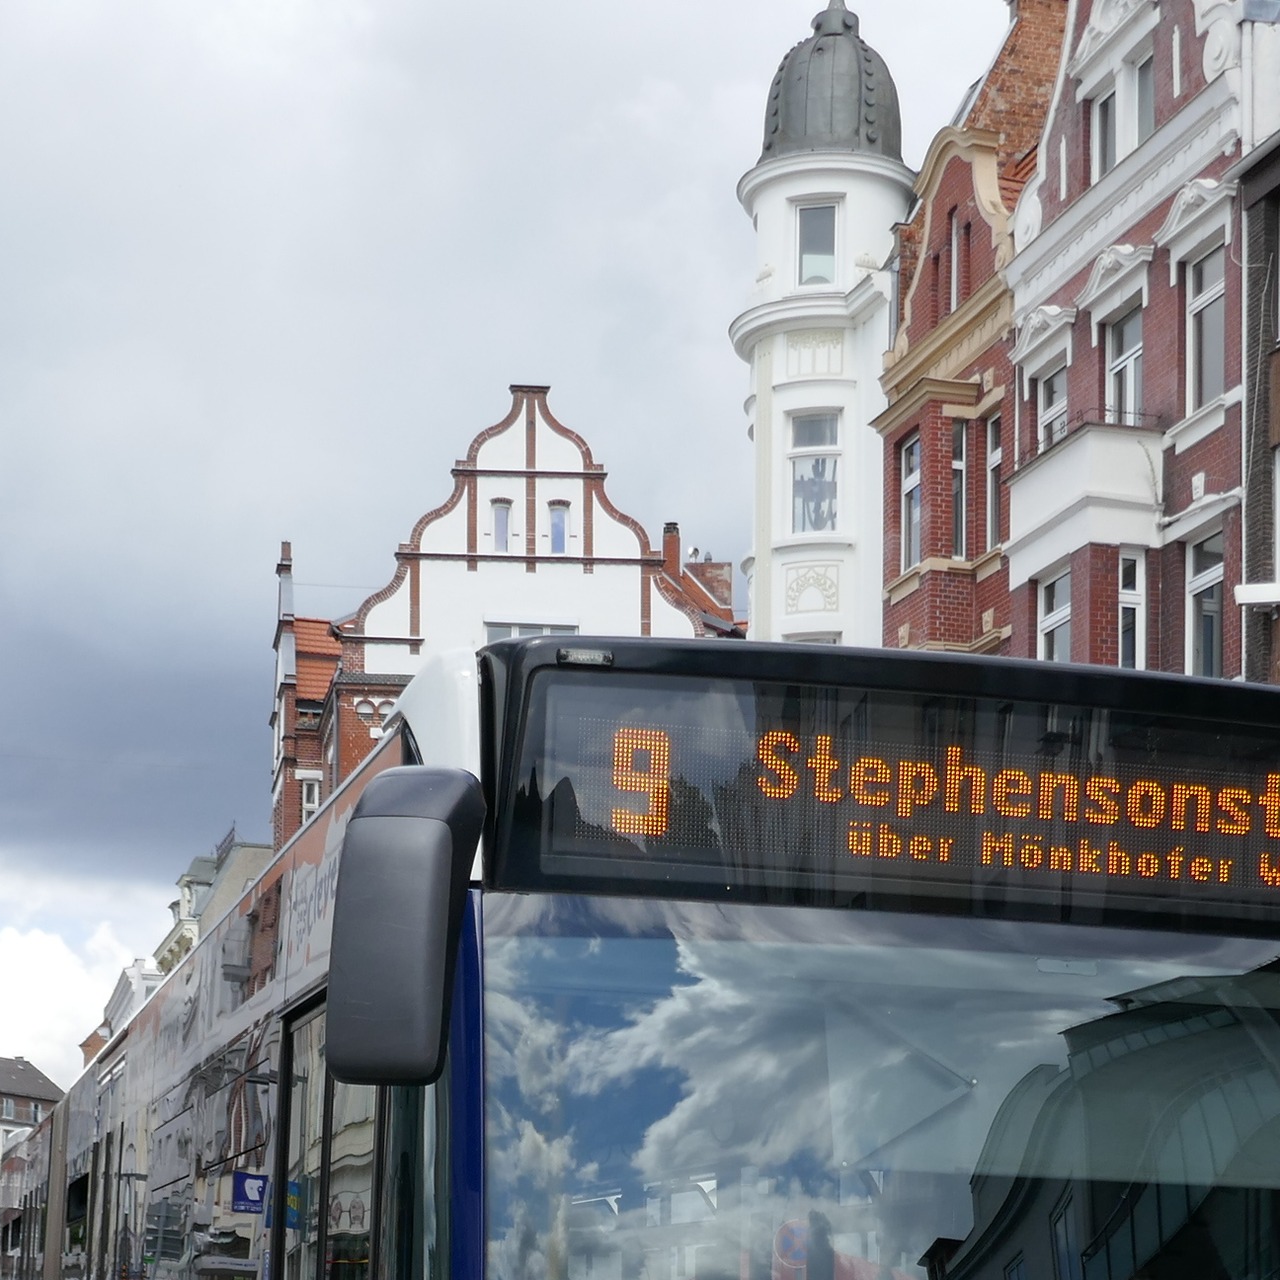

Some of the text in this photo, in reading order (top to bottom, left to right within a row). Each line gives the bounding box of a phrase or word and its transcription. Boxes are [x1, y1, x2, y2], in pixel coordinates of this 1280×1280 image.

[611, 727, 670, 837] 9
[848, 821, 954, 862] über
[980, 830, 1234, 884] Mönkhofer
